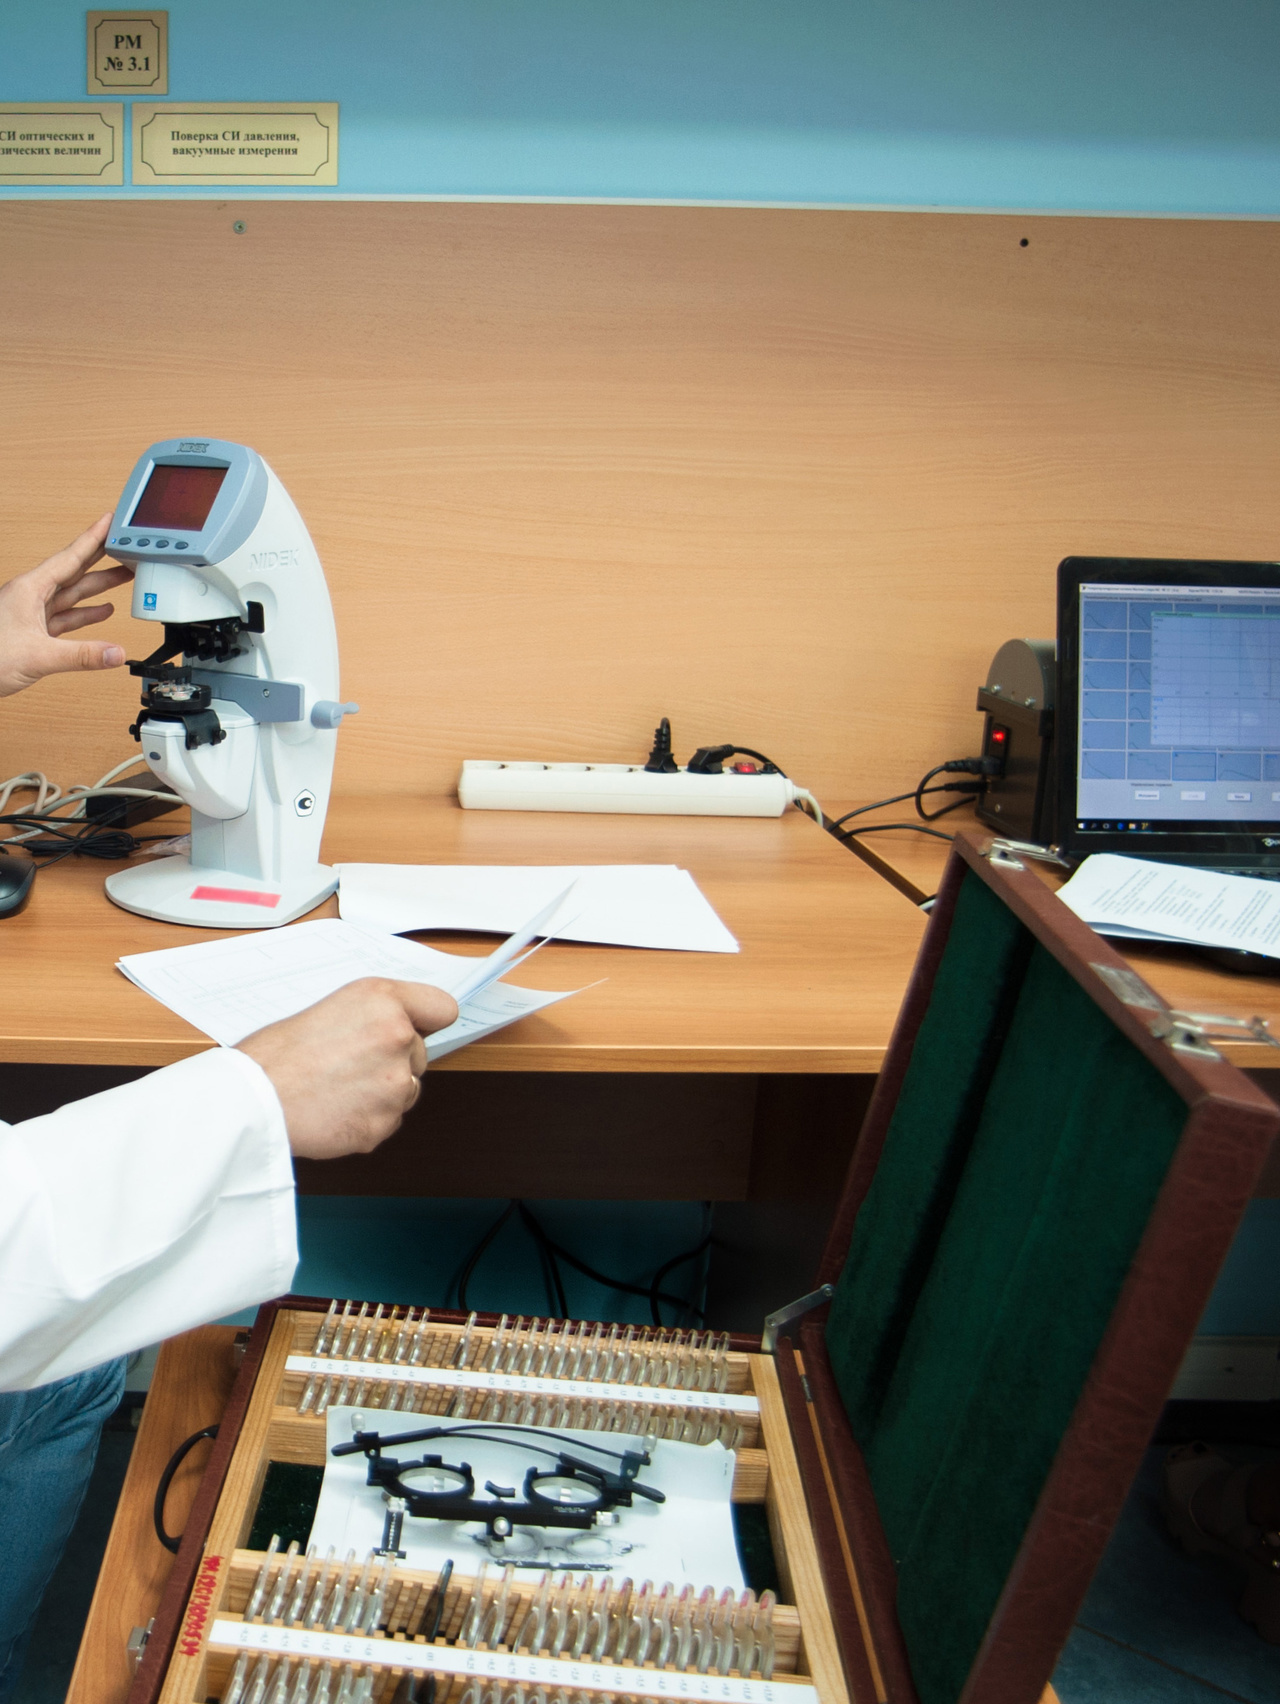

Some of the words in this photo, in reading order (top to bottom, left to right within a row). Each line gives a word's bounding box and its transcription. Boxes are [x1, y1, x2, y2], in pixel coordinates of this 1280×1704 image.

[113, 34, 143, 50] РМ
[103, 56, 124, 72] №
[127, 56, 150, 72] 3.1
[19, 132, 85, 142] оптических
[87, 132, 95, 142] и
[170, 130, 219, 144] Поверка
[221, 130, 241, 142] СИ
[243, 132, 301, 143] давления,
[53, 146, 102, 156] величин
[172, 146, 236, 158] вакуумные
[238, 146, 299, 158] измерения
[248, 549, 300, 572] NIDEK
